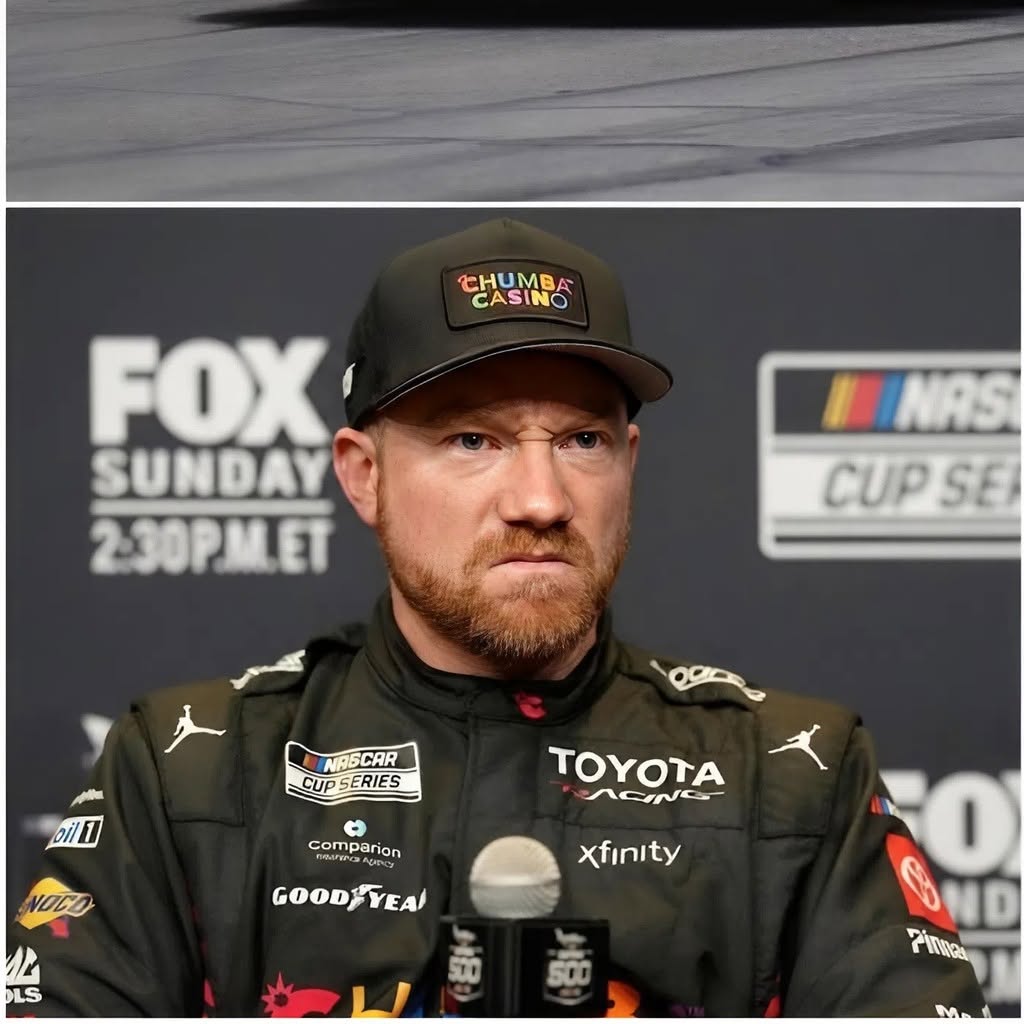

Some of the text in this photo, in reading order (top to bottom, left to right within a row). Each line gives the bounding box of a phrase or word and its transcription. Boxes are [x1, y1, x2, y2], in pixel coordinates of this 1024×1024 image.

[458, 273, 574, 295] CHUMBA
[472, 289, 568, 309] CASINO
[90, 336, 330, 446] FOX
[894, 372, 1021, 430] NAS
[91, 448, 331, 498] SUNDAY
[824, 462, 930, 509] CUP
[323, 751, 398, 774] NASCAR
[548, 746, 726, 789] TOYOTA
[302, 775, 402, 794] CUP SERIES
